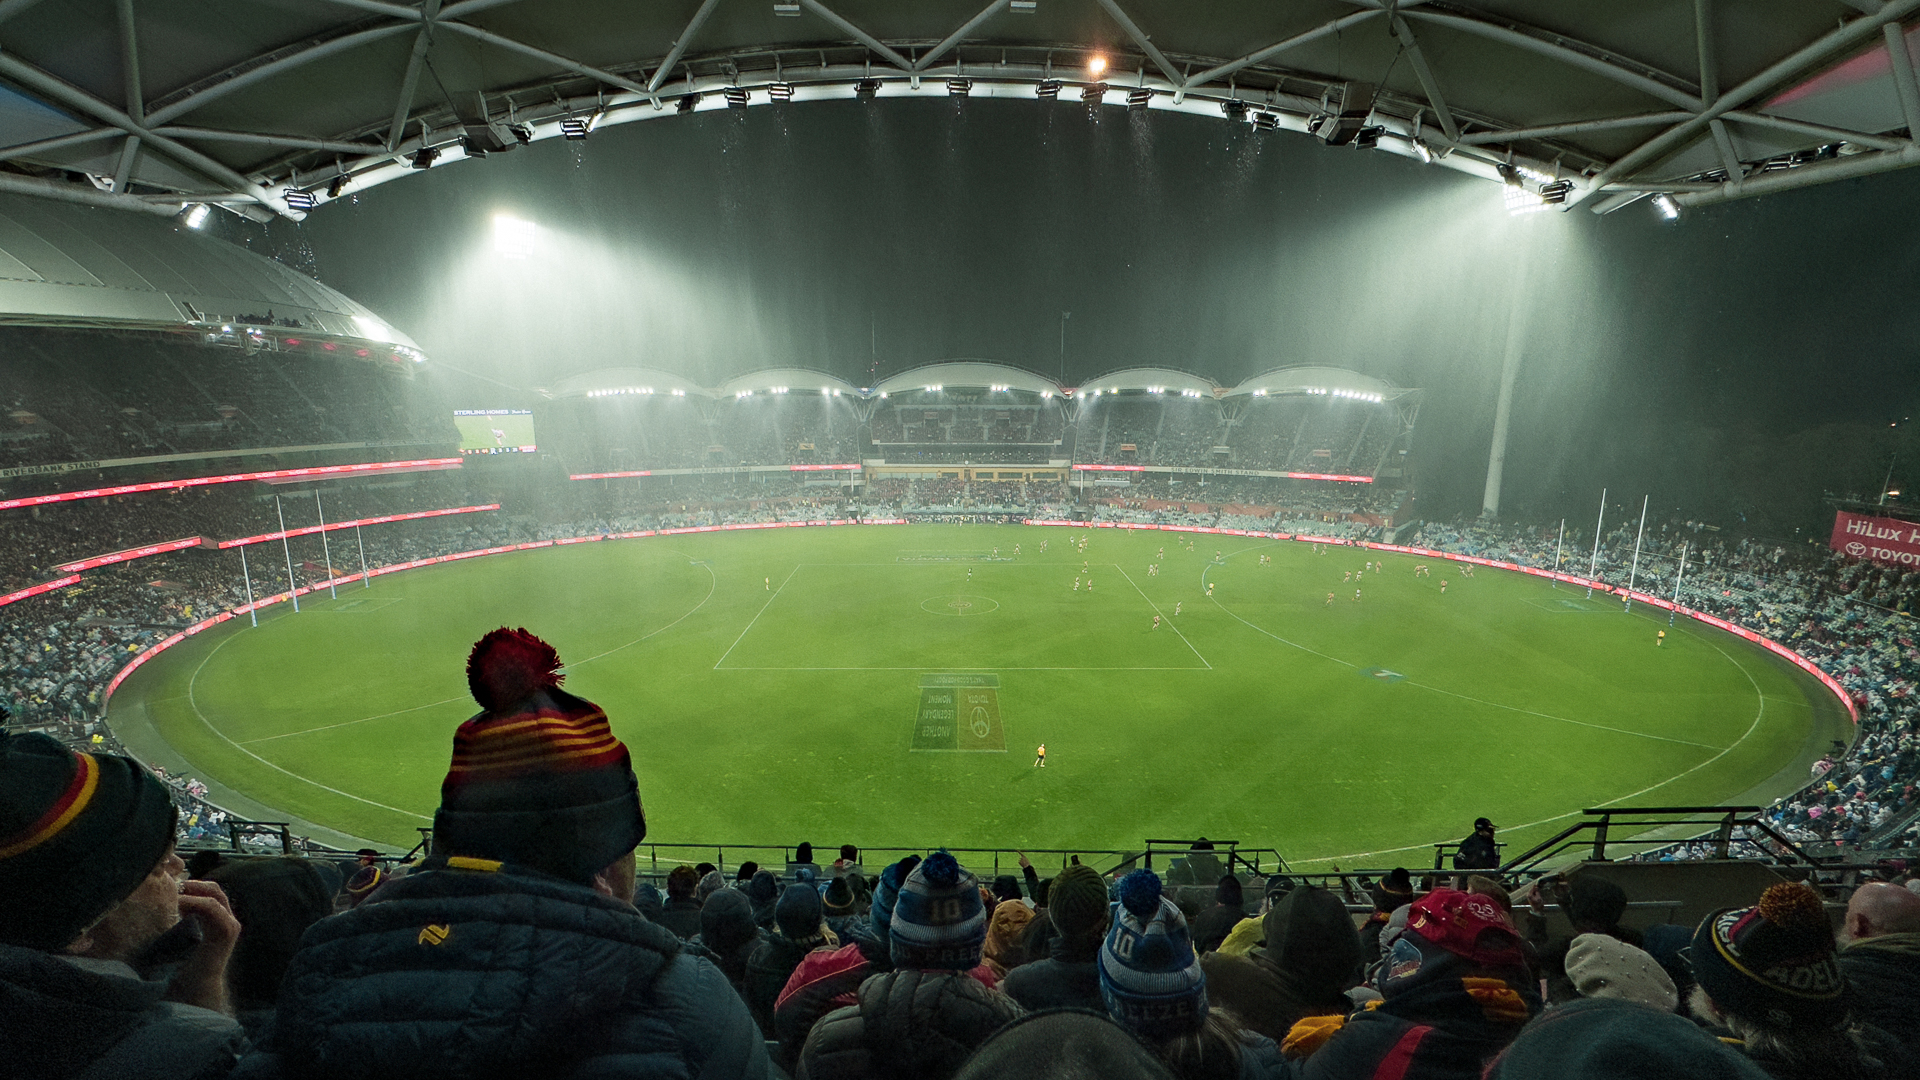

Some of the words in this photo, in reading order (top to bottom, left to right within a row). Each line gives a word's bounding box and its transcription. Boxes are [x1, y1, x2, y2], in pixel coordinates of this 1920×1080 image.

[2, 465, 64, 477] RIVERBANK
[67, 461, 101, 470] STAND
[1846, 519, 1903, 541] HiLux
[928, 694, 952, 703] MOMENT
[968, 694, 989, 703] TOYOTA
[921, 709, 954, 719] LEGENDARY
[922, 726, 951, 737] ANOTHER
[931, 899, 963, 922] 10
[1112, 926, 1136, 963] 10
